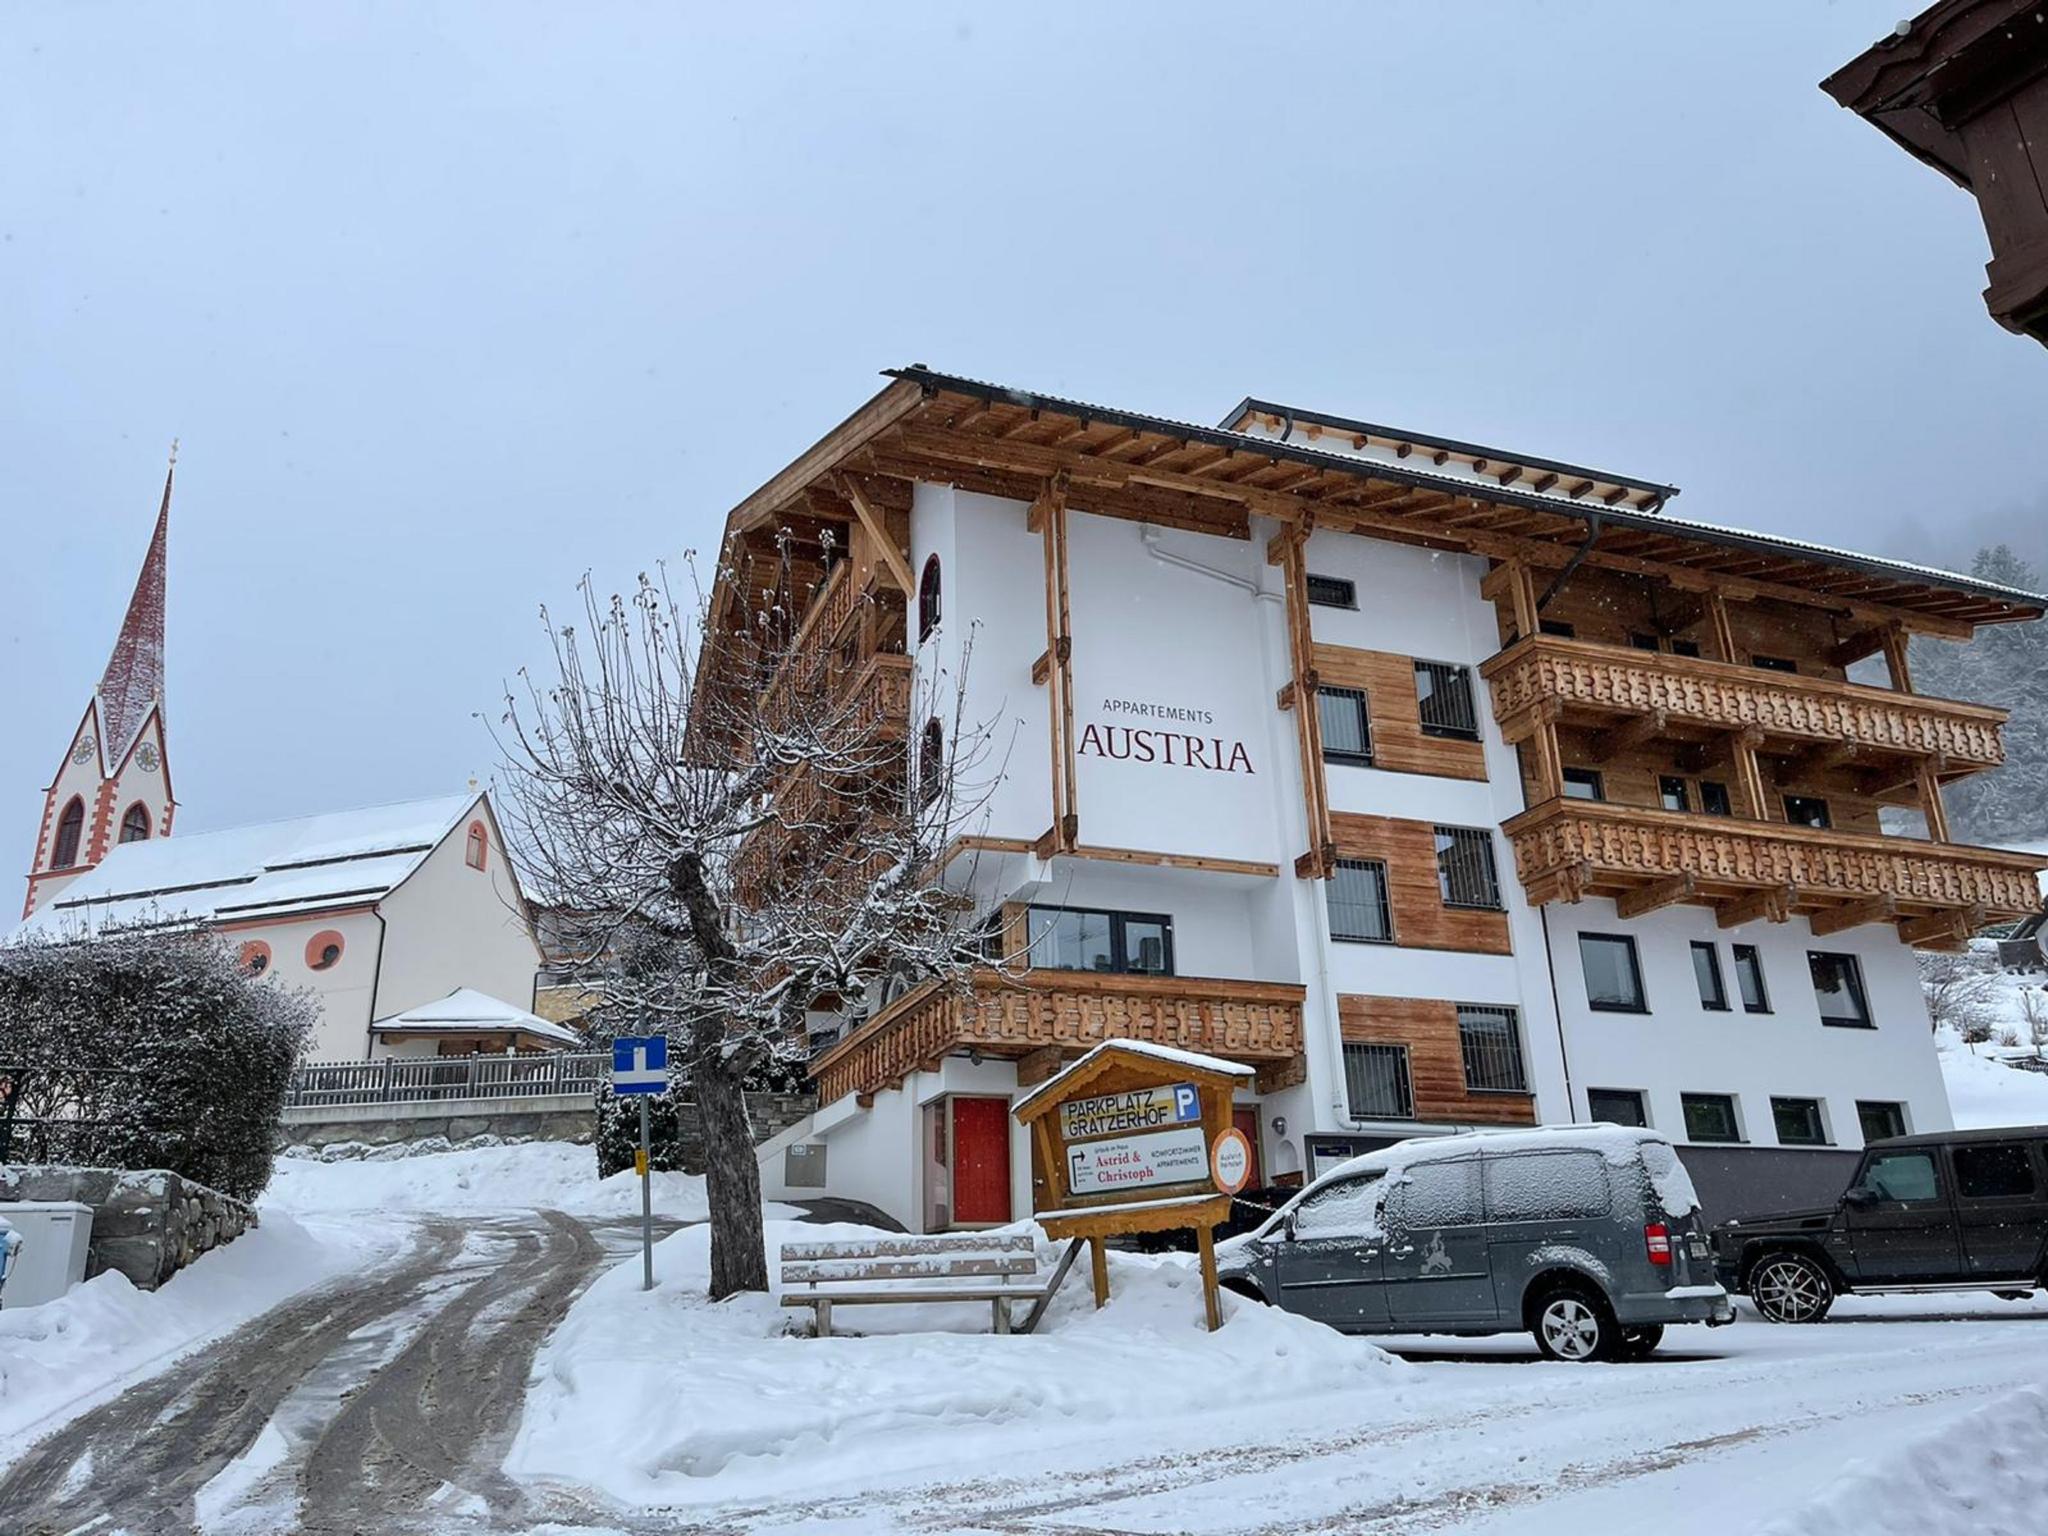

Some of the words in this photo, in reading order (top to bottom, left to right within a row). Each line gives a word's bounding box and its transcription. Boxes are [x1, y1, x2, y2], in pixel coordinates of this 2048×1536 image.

[1102, 699, 1213, 724] APPARTEMENTS
[1077, 724, 1256, 774] AUSTRIA
[1067, 1091, 1155, 1120] PARKPLATZ
[1176, 1089, 1194, 1117] P
[1068, 1106, 1168, 1137] GRATZERHOF
[1096, 1151, 1130, 1168] Astrid
[1132, 1150, 1142, 1163] &
[1097, 1165, 1154, 1183] Christoph
